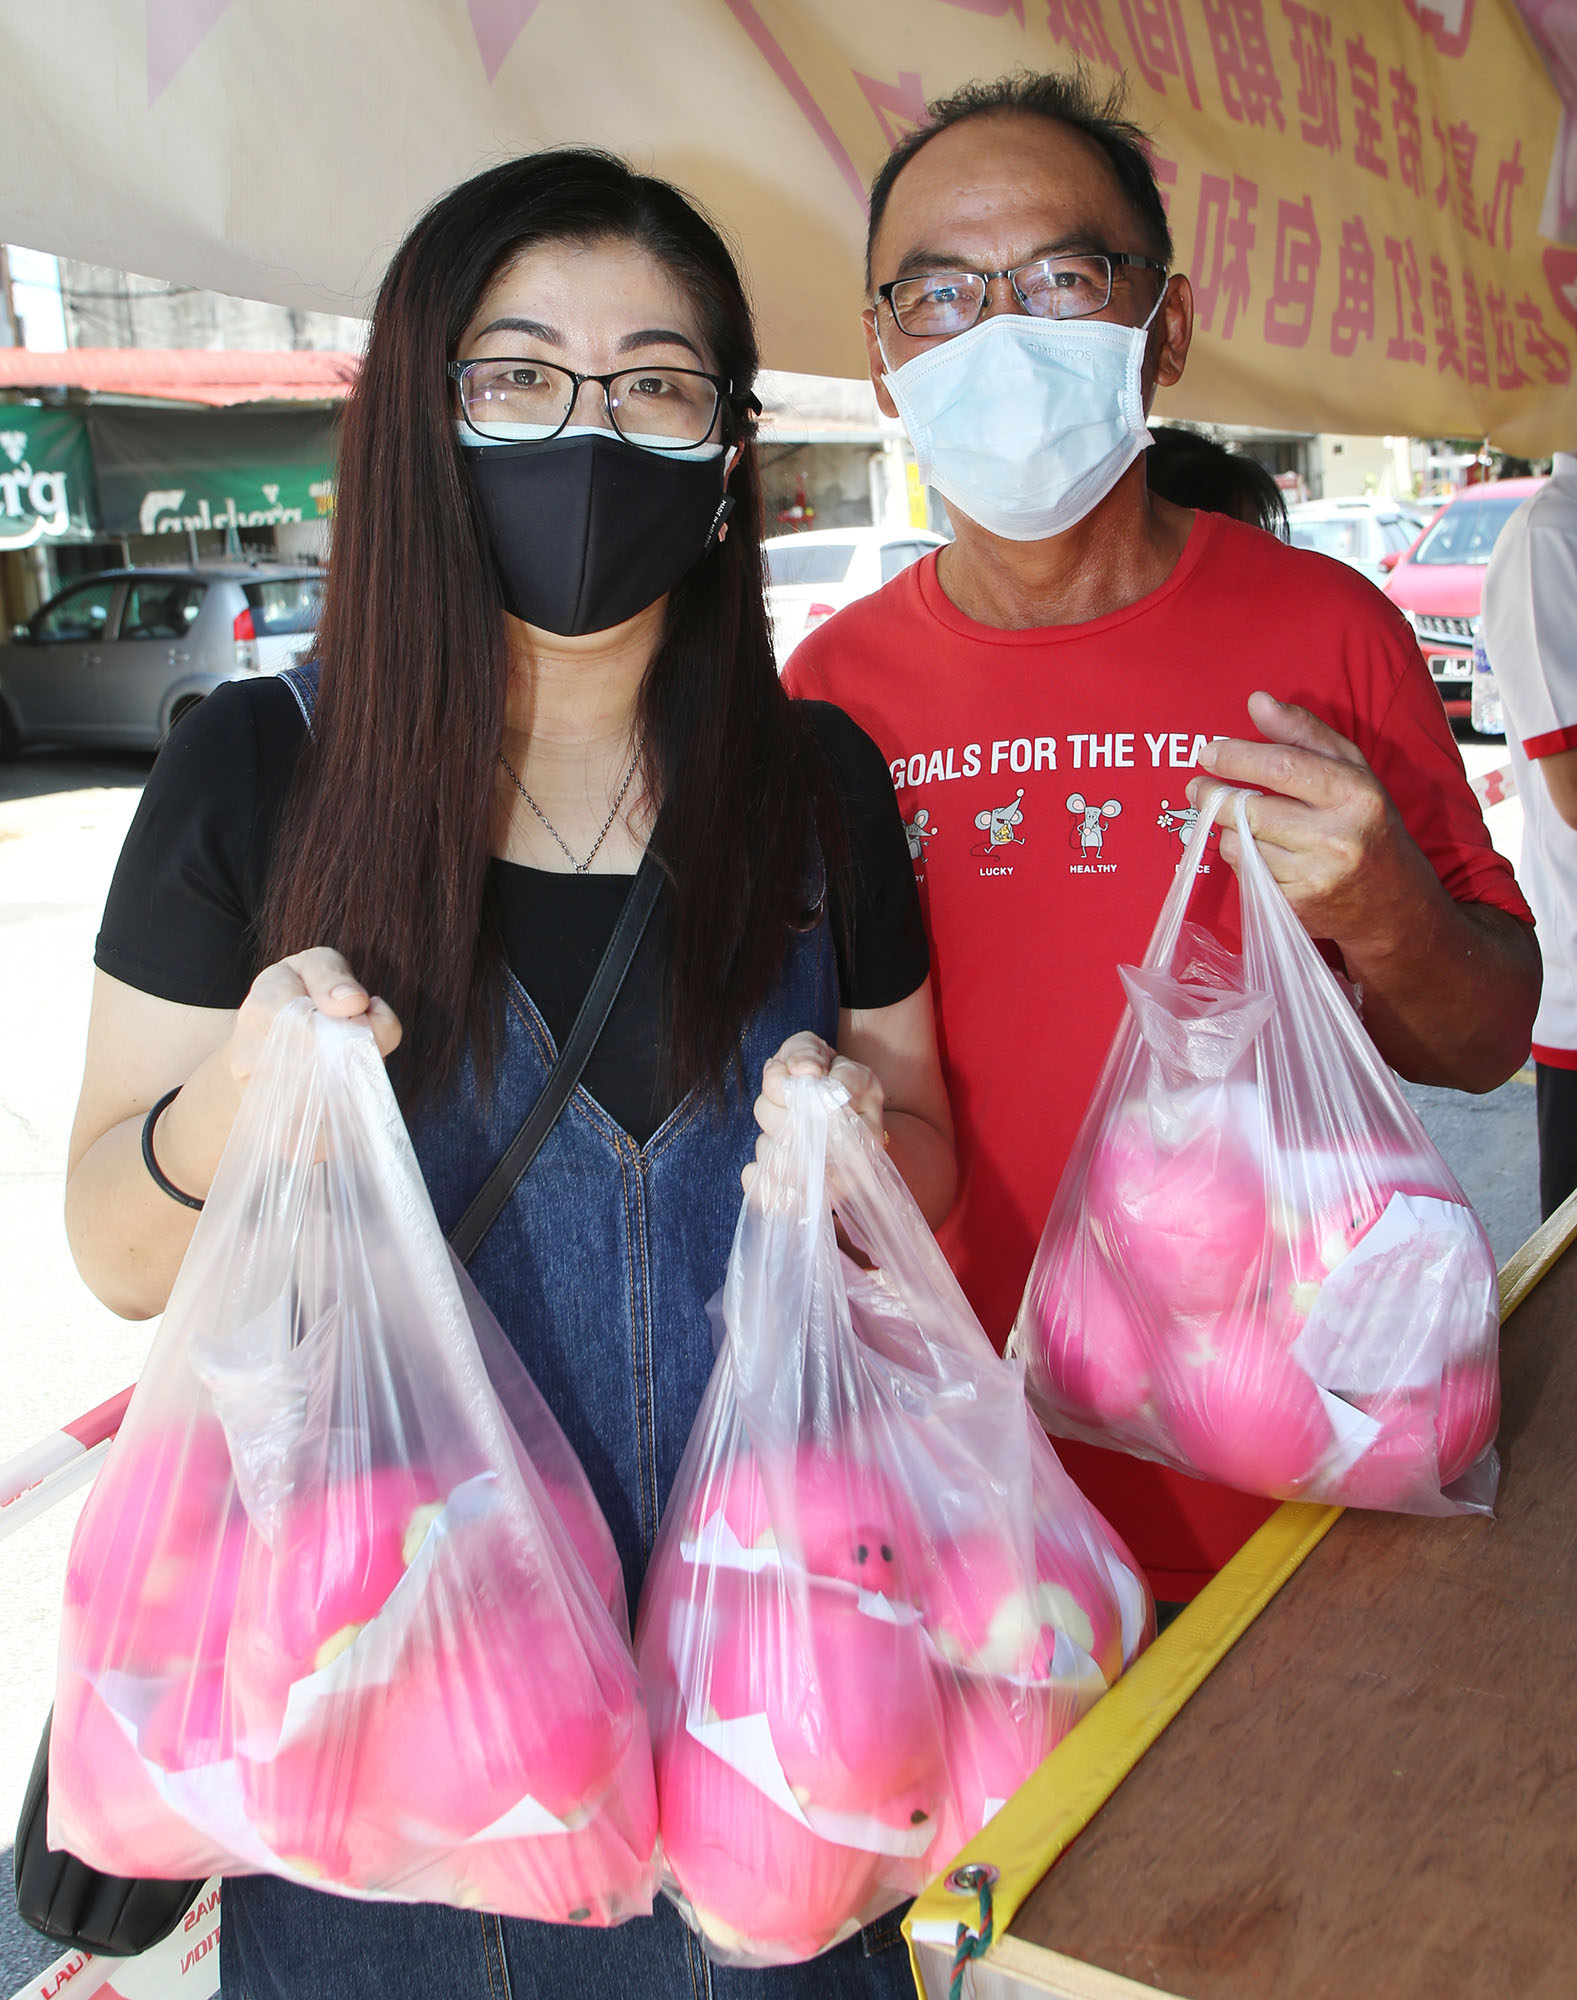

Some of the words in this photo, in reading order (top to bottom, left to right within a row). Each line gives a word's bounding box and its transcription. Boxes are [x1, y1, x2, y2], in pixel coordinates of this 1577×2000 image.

[1039, 343, 1094, 361] MEDICOS
[889, 744, 981, 791] GOALS
[990, 736, 1057, 774] FOR
[1066, 733, 1134, 769] THE
[1143, 733, 1231, 769] YEA
[979, 866, 1014, 877] LUCKY
[1069, 864, 1118, 874] HEALTHY
